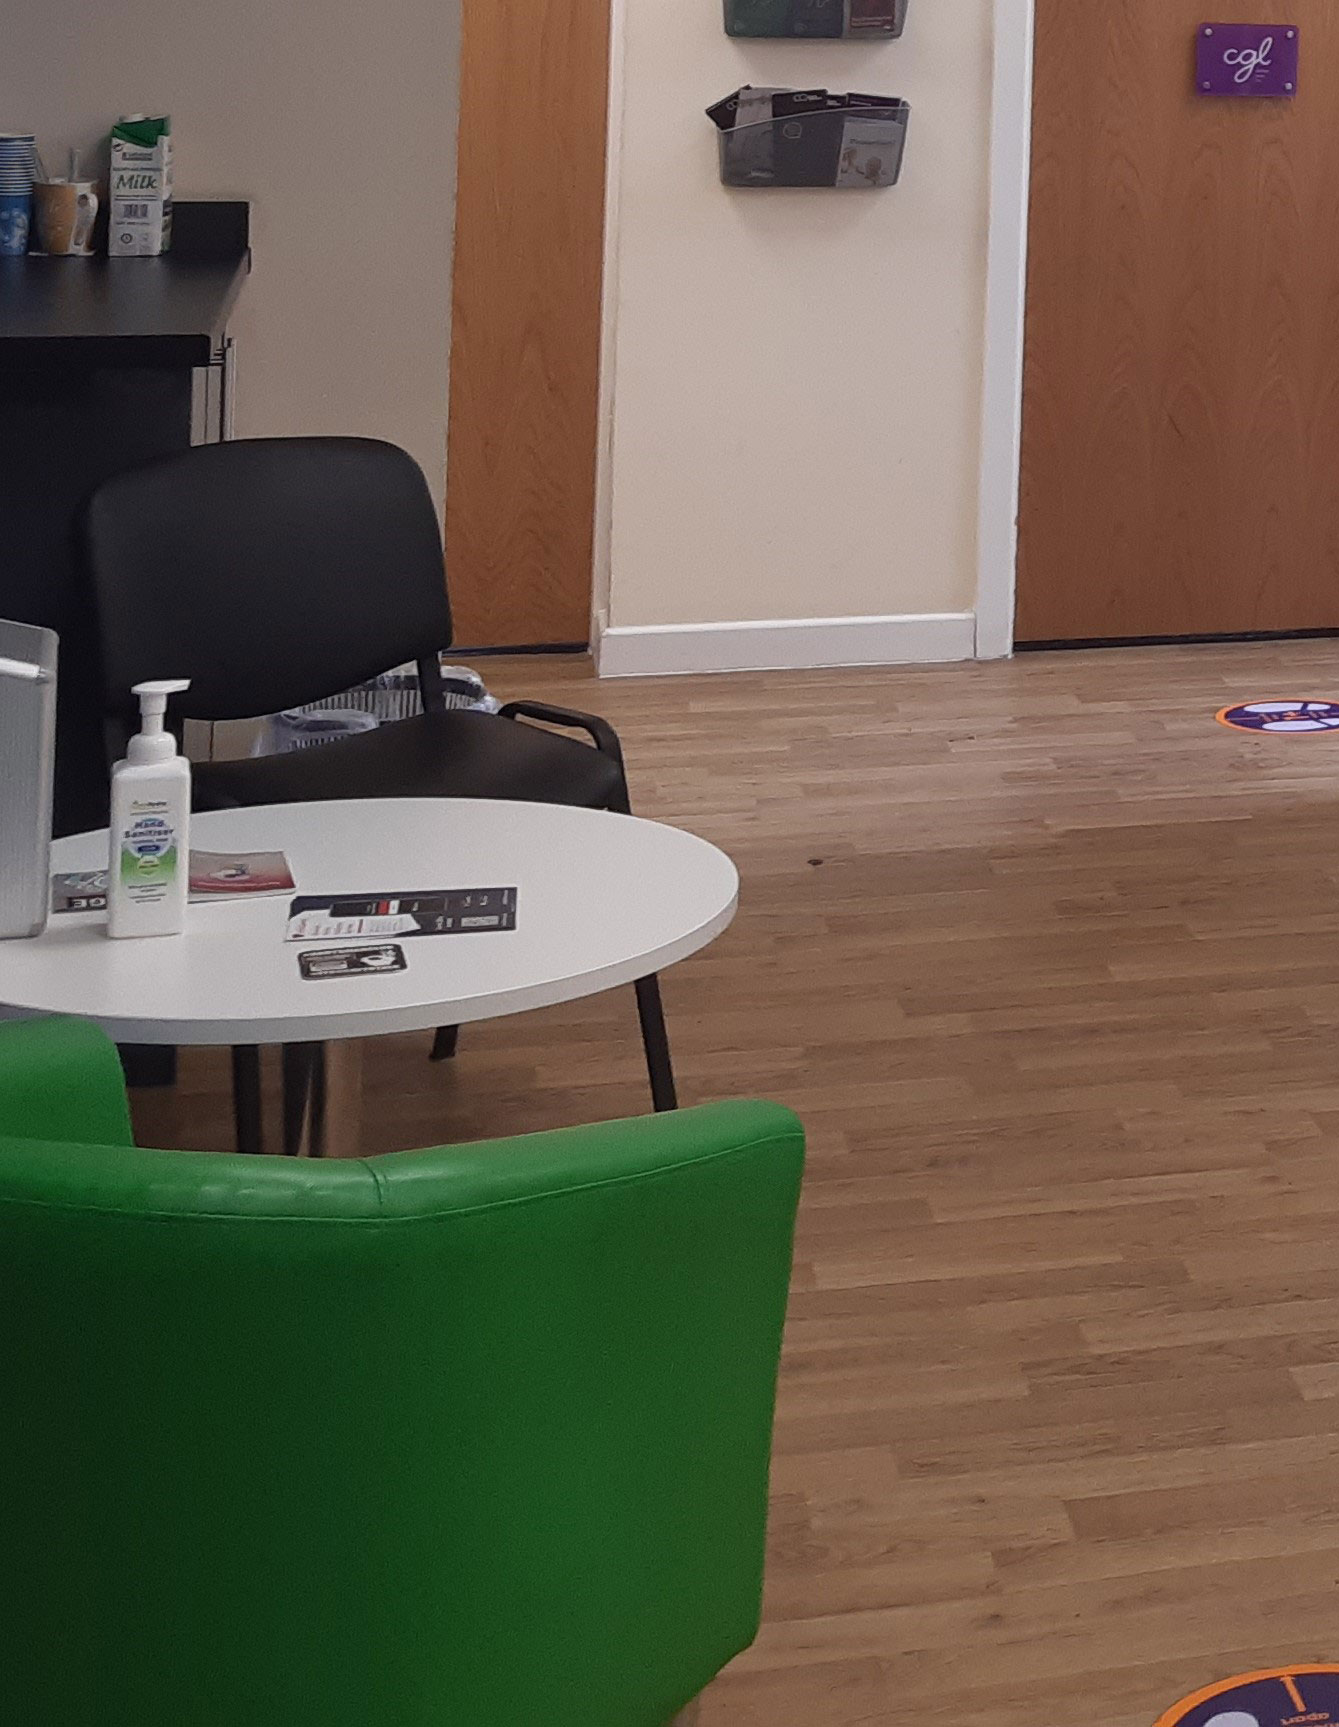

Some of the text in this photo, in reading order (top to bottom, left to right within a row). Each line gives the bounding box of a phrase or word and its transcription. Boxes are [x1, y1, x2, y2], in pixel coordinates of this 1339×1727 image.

[1223, 36, 1273, 83] cgl
[116, 174, 158, 190] Milk
[134, 819, 165, 829] Hand
[123, 828, 174, 839] Sanitiser
